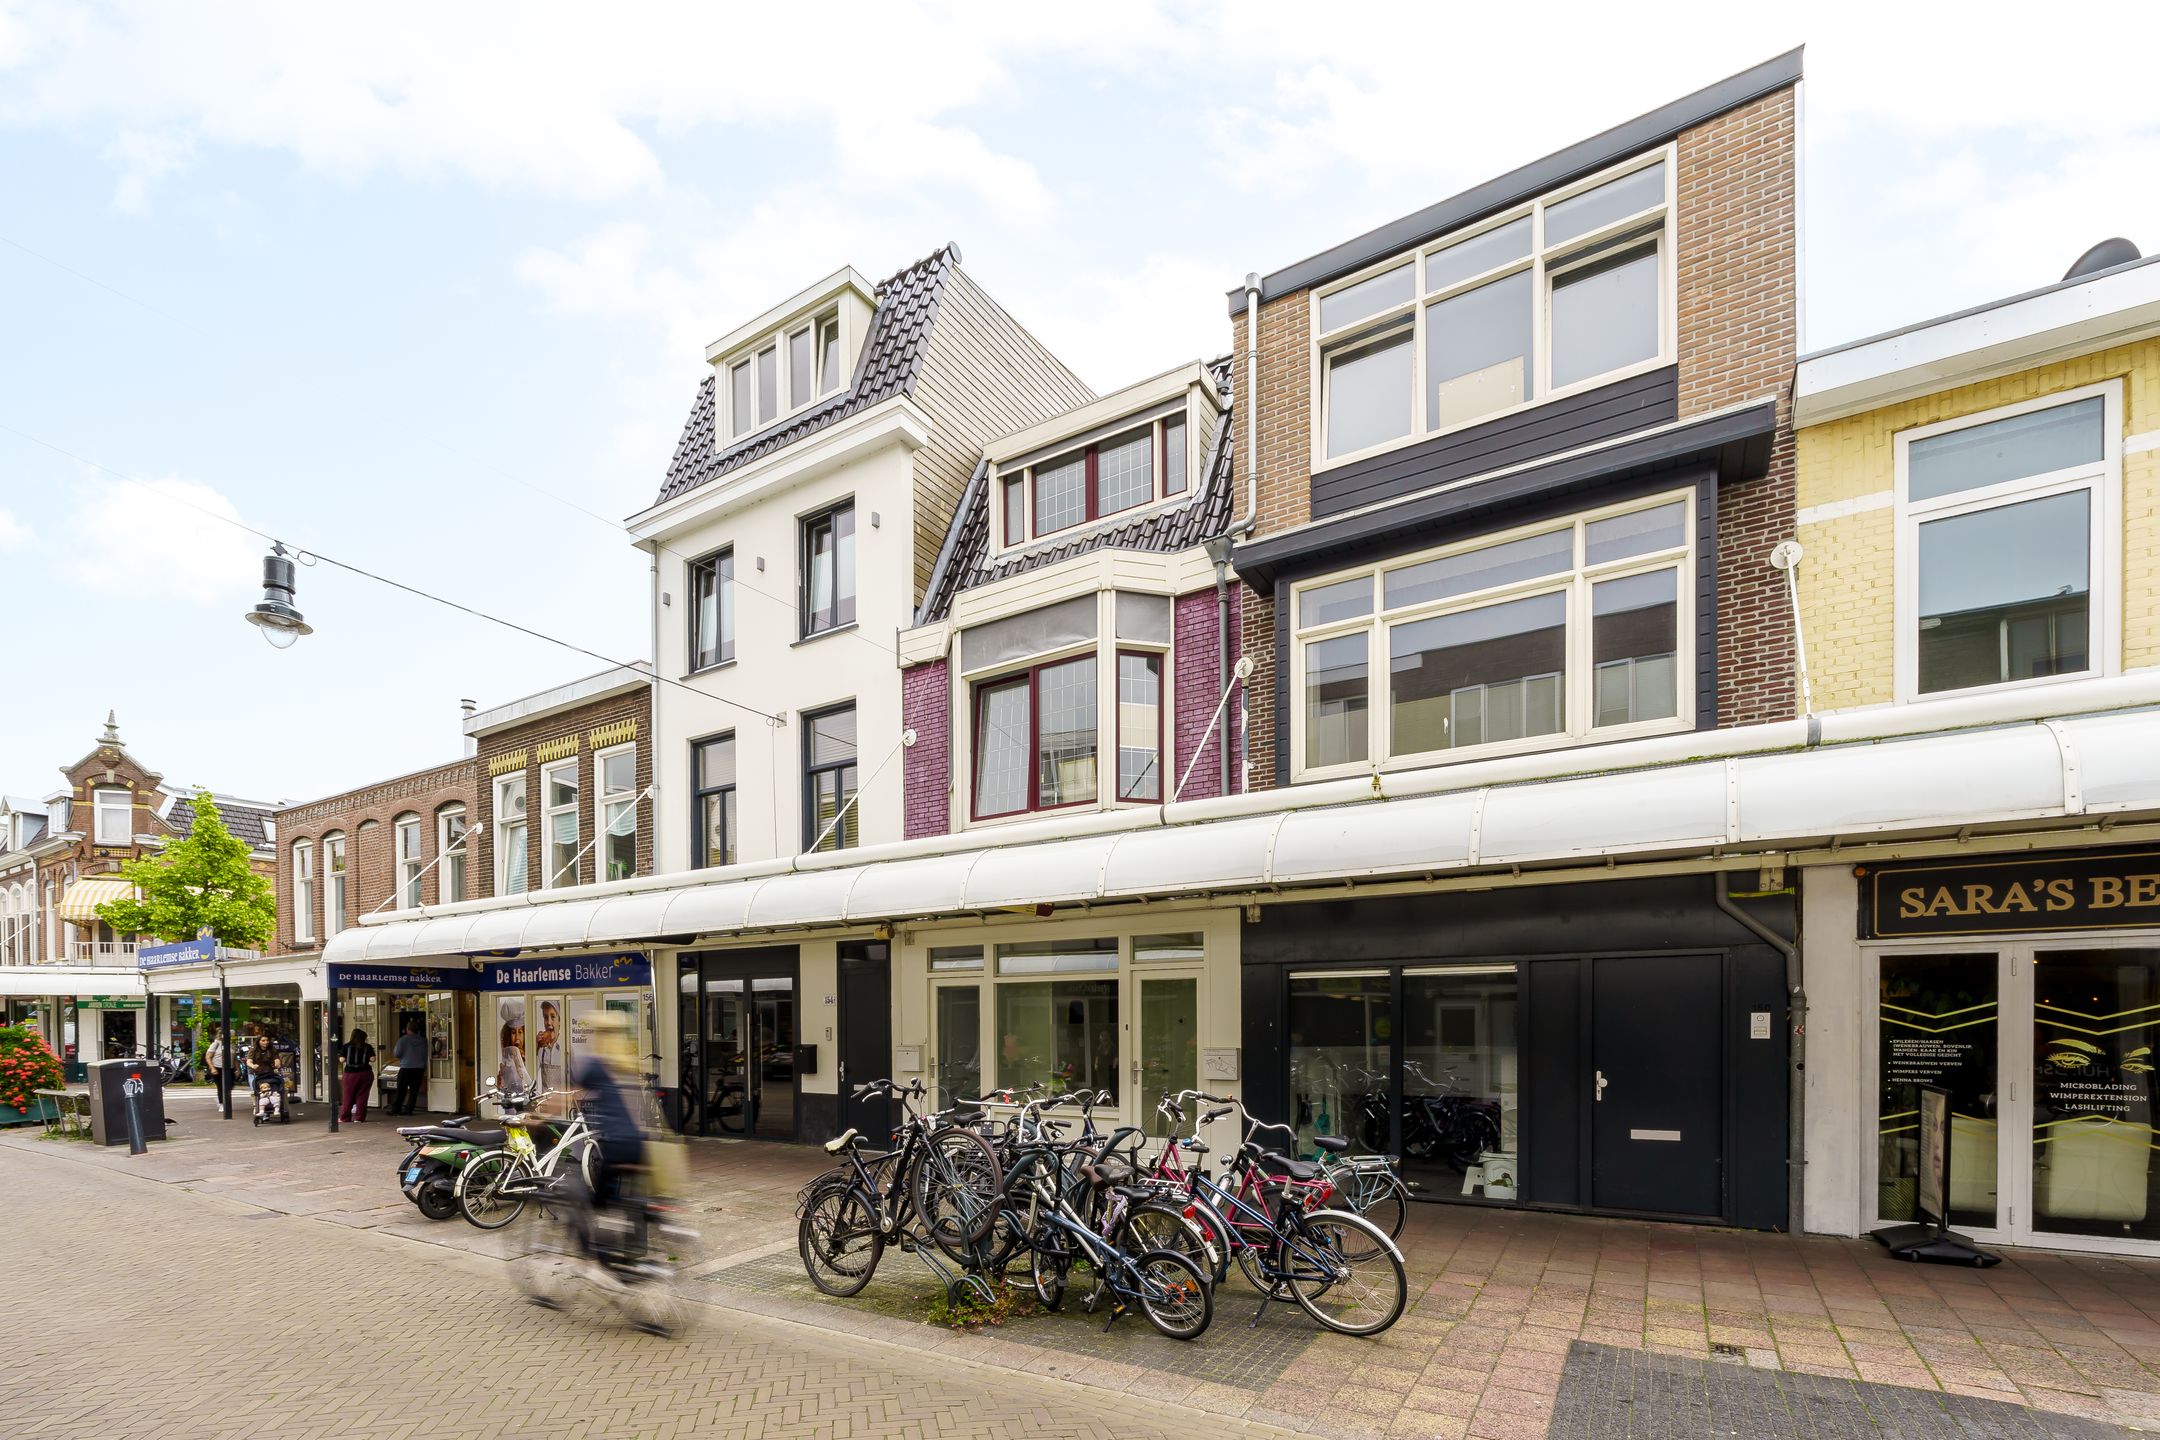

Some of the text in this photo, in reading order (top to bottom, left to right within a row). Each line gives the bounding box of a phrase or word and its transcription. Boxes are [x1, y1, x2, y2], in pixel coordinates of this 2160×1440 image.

[1900, 878, 2075, 919] SARA'S
[496, 964, 613, 984] De Haarlemse Bakker
[2060, 1082, 2137, 1091] MICROBLADING
[2049, 1092, 2148, 1102] WIMPEREXTENSION
[2064, 1103, 2131, 1112] LASHLIFTING
